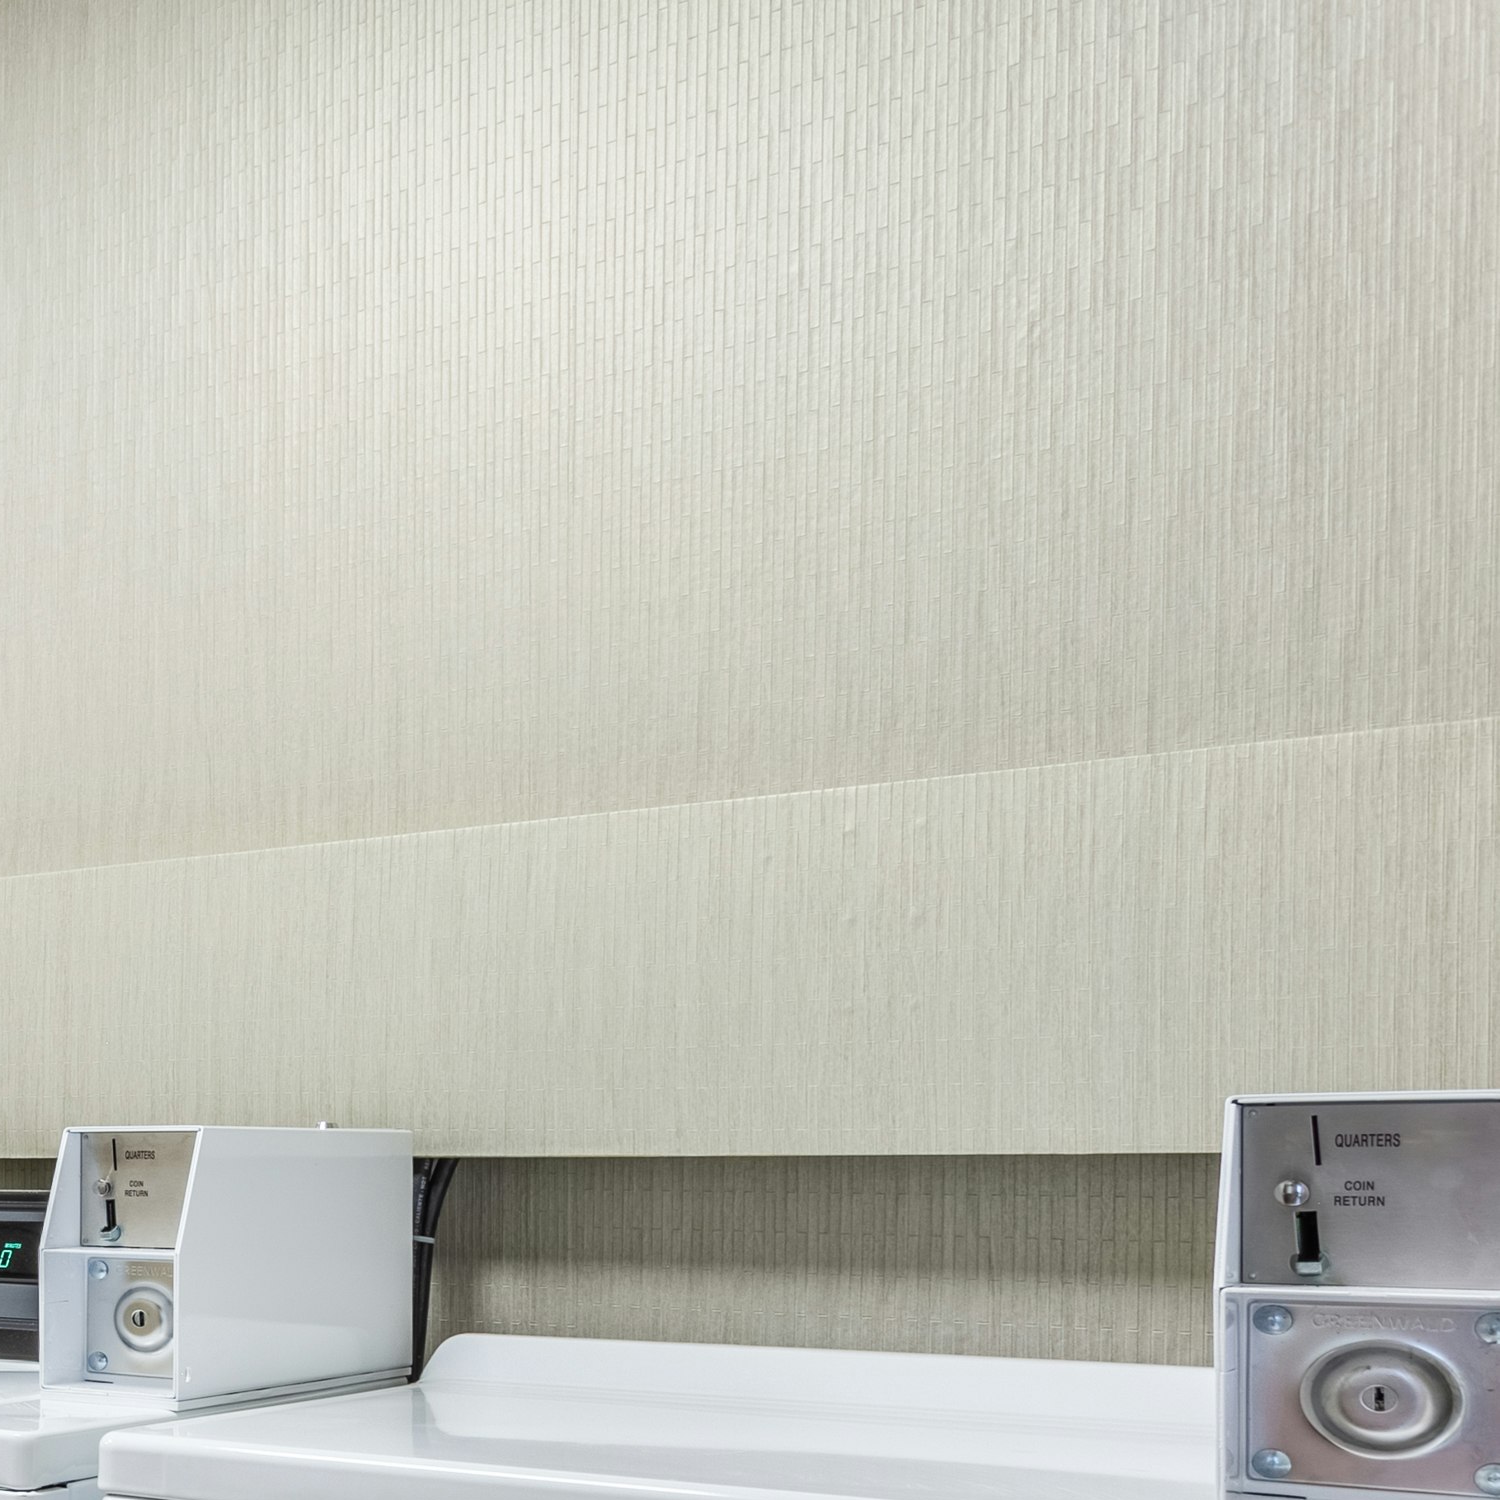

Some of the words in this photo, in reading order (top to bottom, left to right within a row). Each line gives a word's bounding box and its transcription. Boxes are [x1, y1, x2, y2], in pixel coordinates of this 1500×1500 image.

[1335, 1133, 1401, 1148] QUARTERS
[125, 1150, 155, 1160] QUARTERS
[1344, 1181, 1375, 1191] COIN
[1334, 1196, 1386, 1206] RETURN
[116, 1264, 173, 1278] GREENWAL
[1312, 1312, 1457, 1333] GREENWALD
